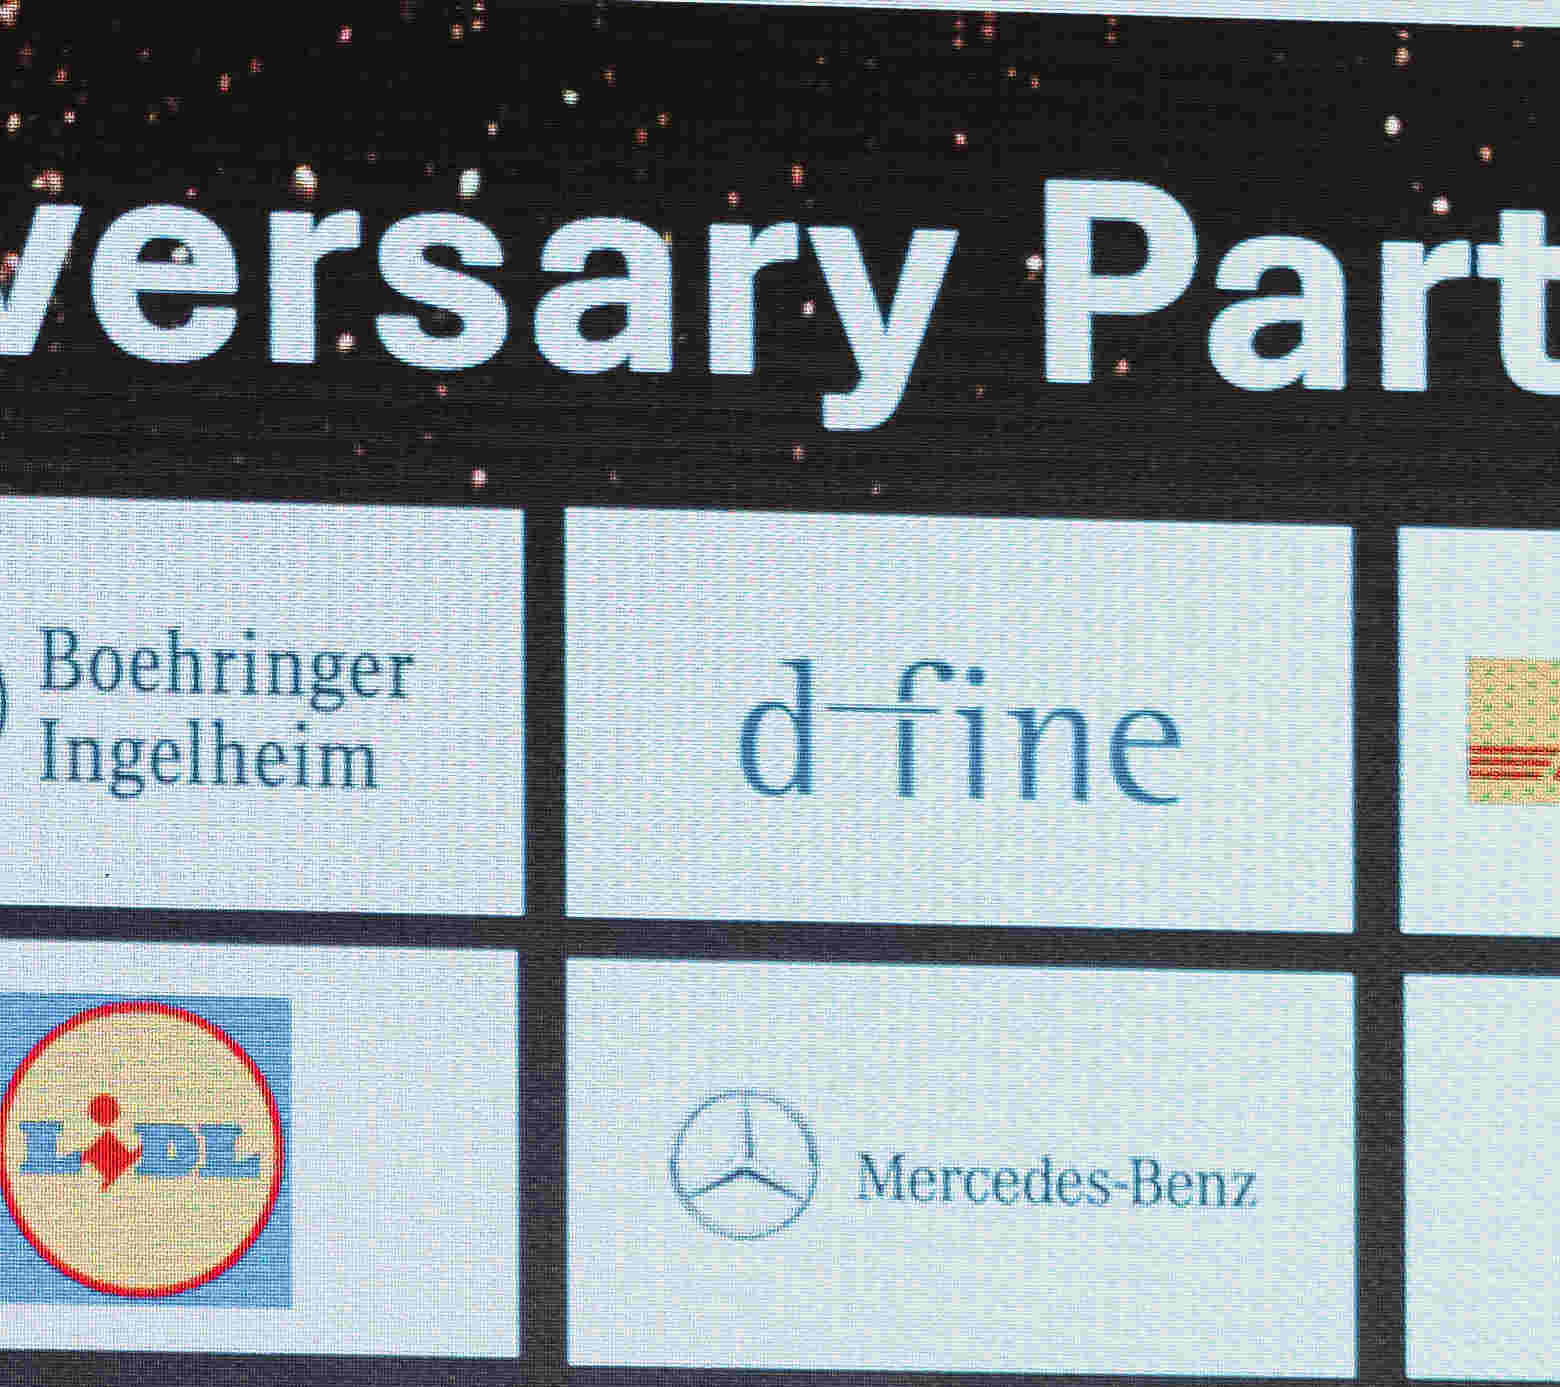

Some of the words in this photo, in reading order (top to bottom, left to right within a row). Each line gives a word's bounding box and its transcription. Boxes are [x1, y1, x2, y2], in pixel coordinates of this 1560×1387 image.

[41, 626, 414, 713] Boehringer
[41, 718, 377, 800] Ingelheim
[739, 657, 1180, 805] d-fine
[859, 1152, 1256, 1208] Mercedes-Benz
